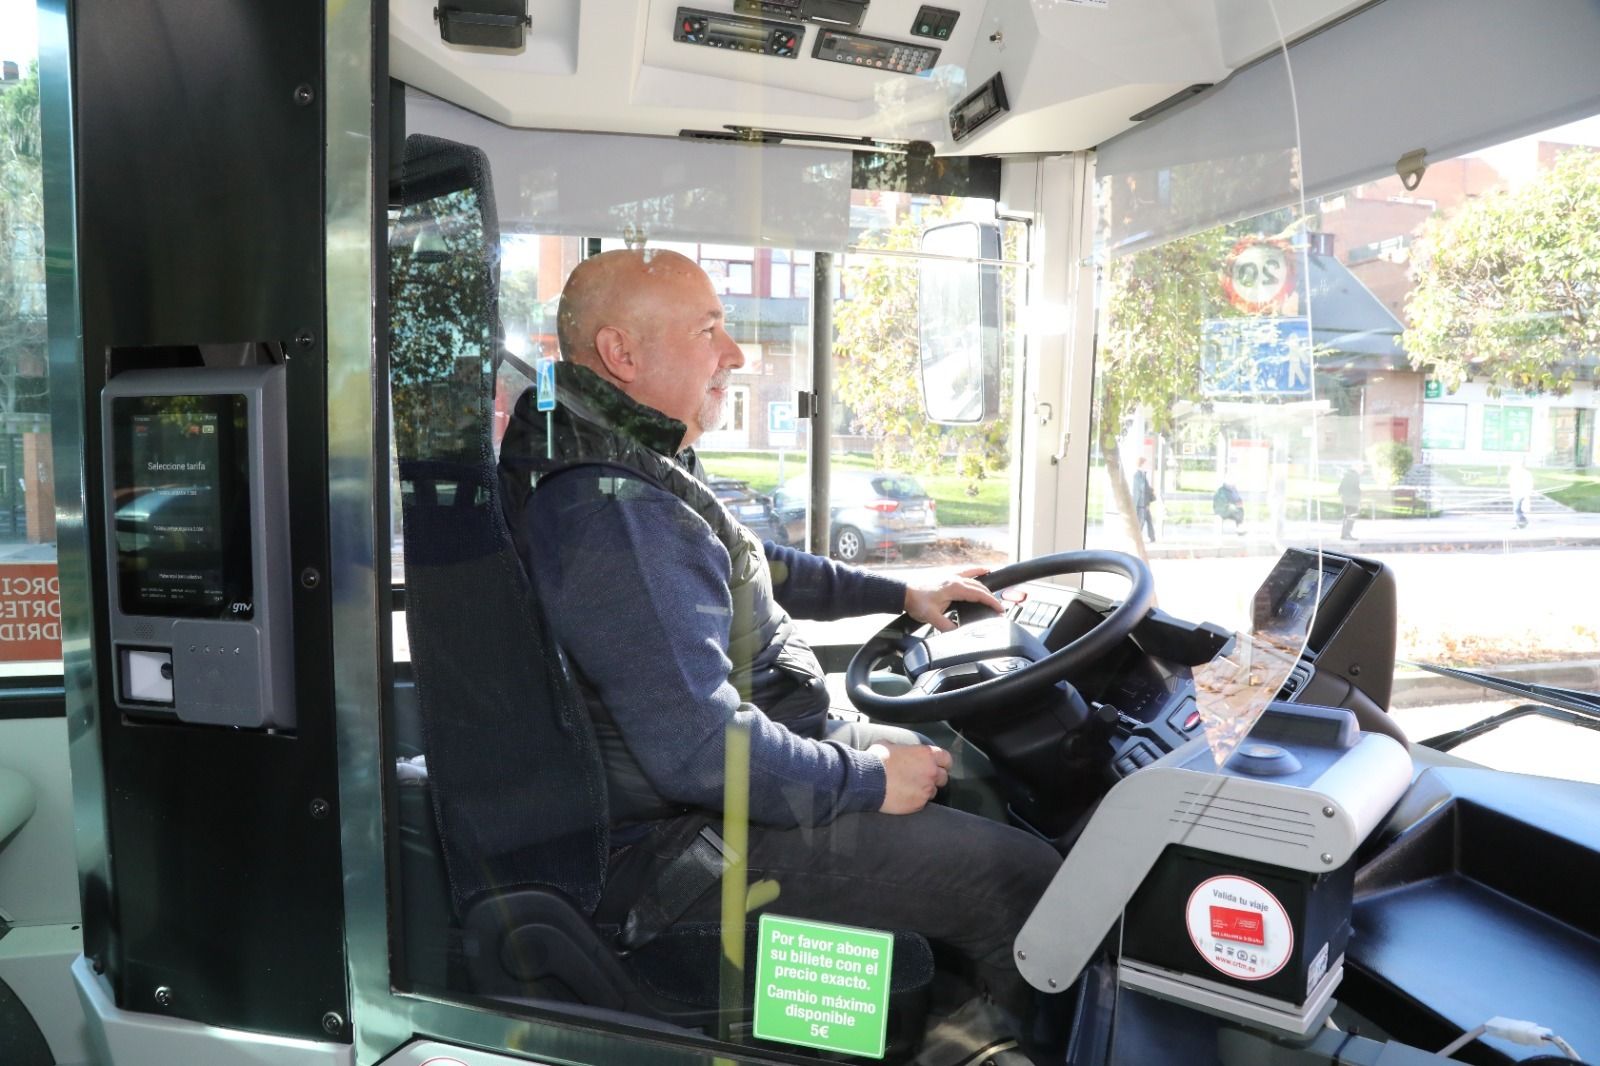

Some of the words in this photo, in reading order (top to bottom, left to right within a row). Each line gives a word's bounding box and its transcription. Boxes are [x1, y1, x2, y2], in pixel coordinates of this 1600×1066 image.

[147, 461, 185, 471] Seleccione
[186, 461, 206, 471] tarifa
[232, 602, 252, 612] gmv
[1213, 888, 1237, 903] Valida
[1239, 896, 1248, 906] tu
[1249, 899, 1269, 912] viaje
[771, 930, 794, 946] Por
[798, 934, 834, 952] favor
[836, 942, 879, 959] abone
[770, 949, 787, 960] su
[790, 950, 833, 968] billete
[835, 957, 861, 973] con
[865, 962, 878, 976] el
[774, 965, 817, 982] precio
[821, 972, 871, 991] exacto.
[767, 984, 817, 1004] Cambio
[821, 994, 876, 1014] máximo
[785, 1004, 855, 1026] disponible
[810, 1023, 829, 1038] 5€
